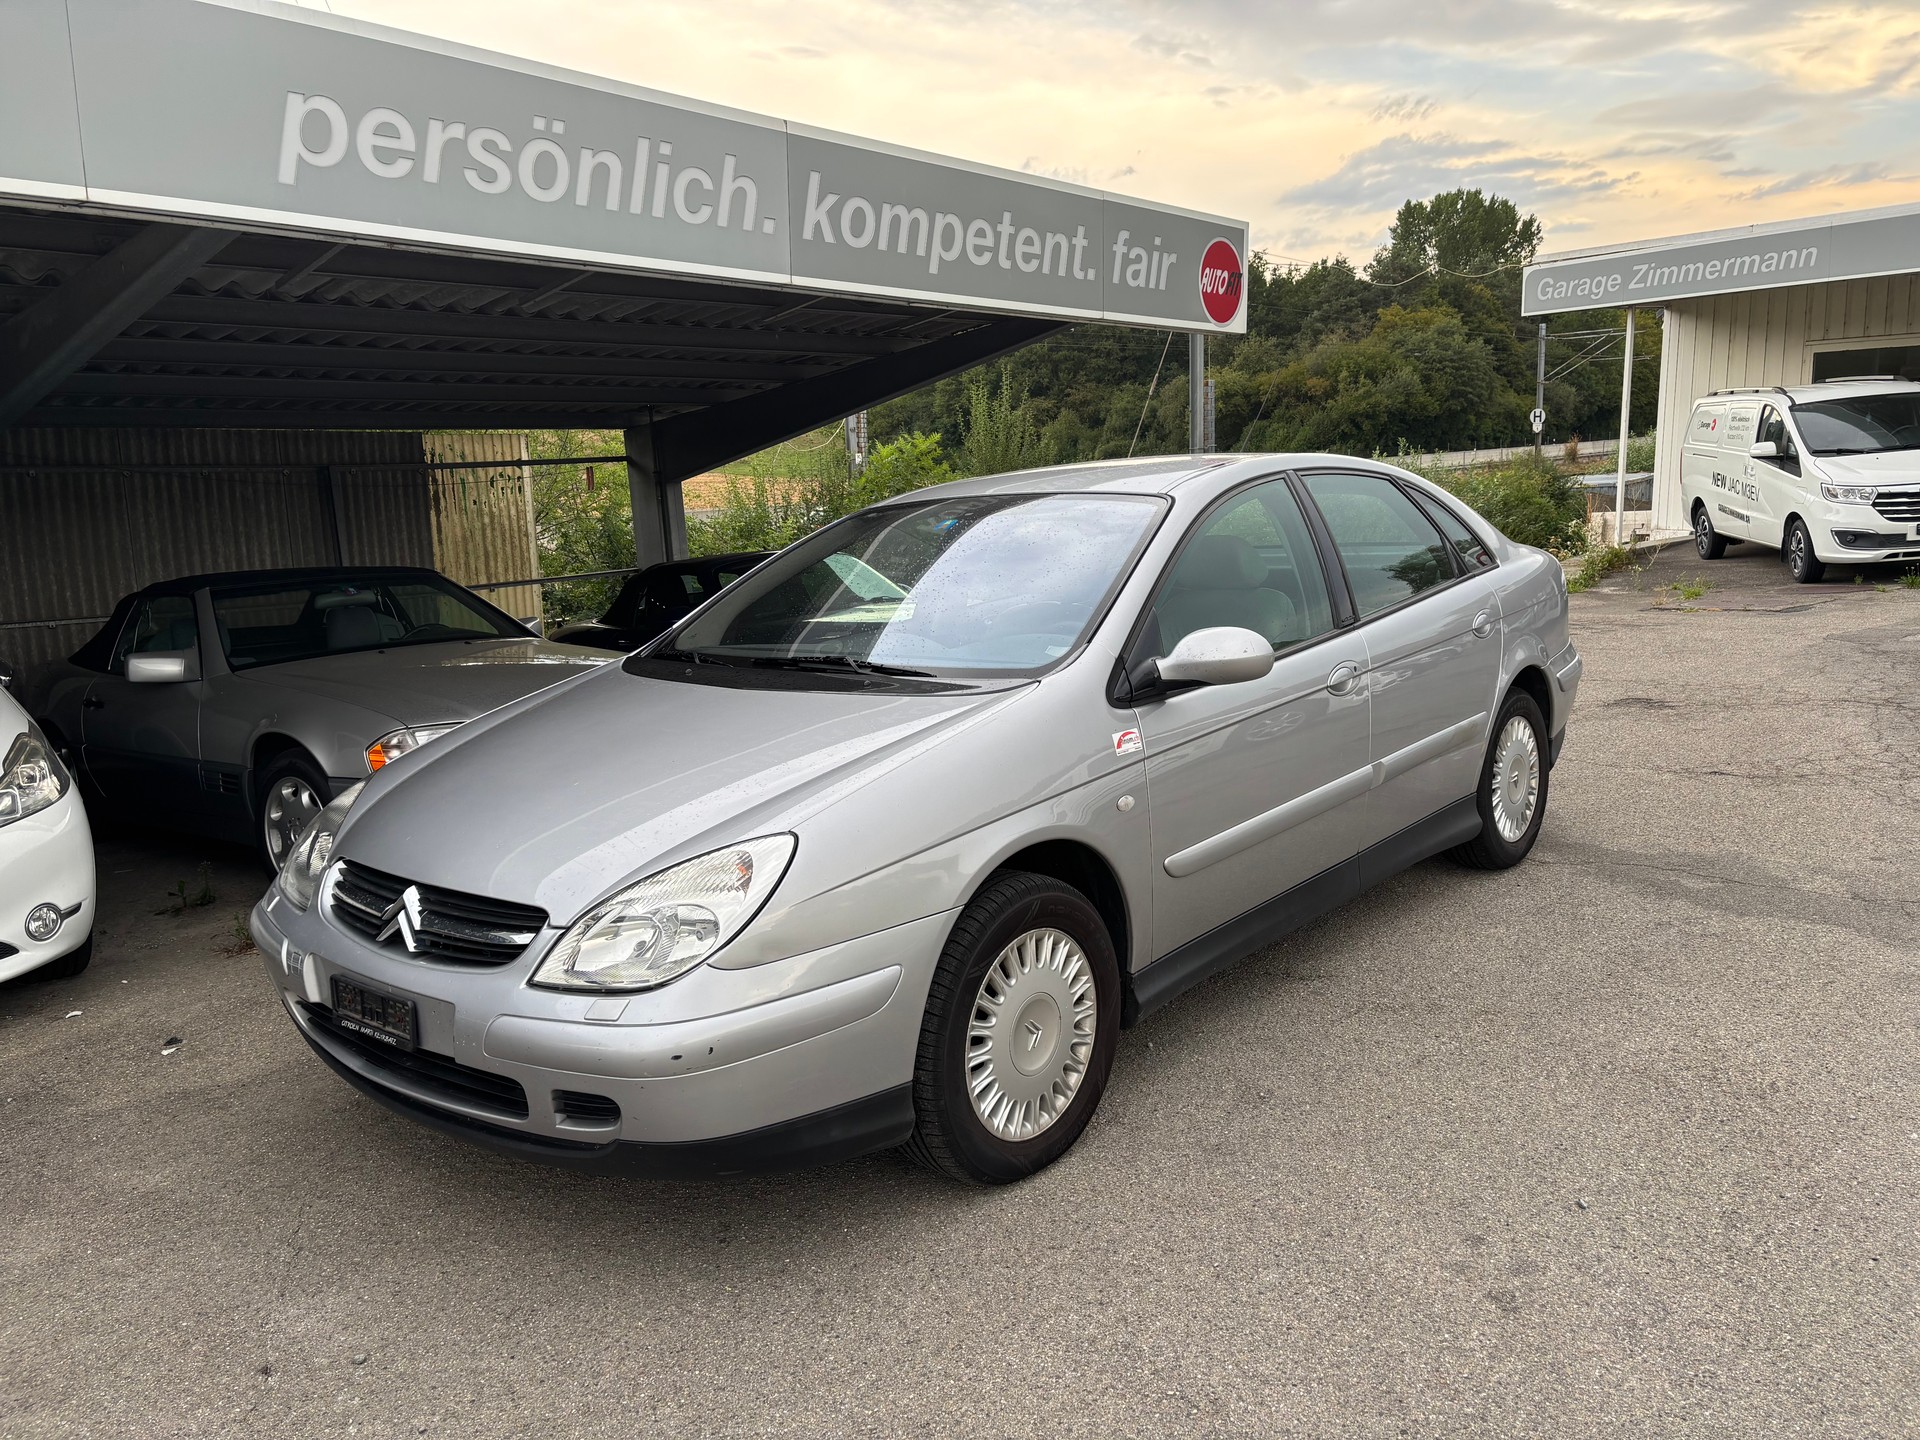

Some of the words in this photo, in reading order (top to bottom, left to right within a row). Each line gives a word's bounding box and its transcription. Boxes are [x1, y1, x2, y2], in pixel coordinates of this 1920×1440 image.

[277, 91, 776, 234] persönlich.
[802, 169, 1097, 281] kompetent.
[1111, 228, 1178, 291] fair
[1537, 274, 1621, 300] Garage
[1628, 245, 1818, 288] Zimmermann
[1533, 410, 1542, 423] H
[1711, 471, 1726, 489] NEW
[1728, 476, 1740, 495] JAC
[1741, 481, 1761, 502] M3EV
